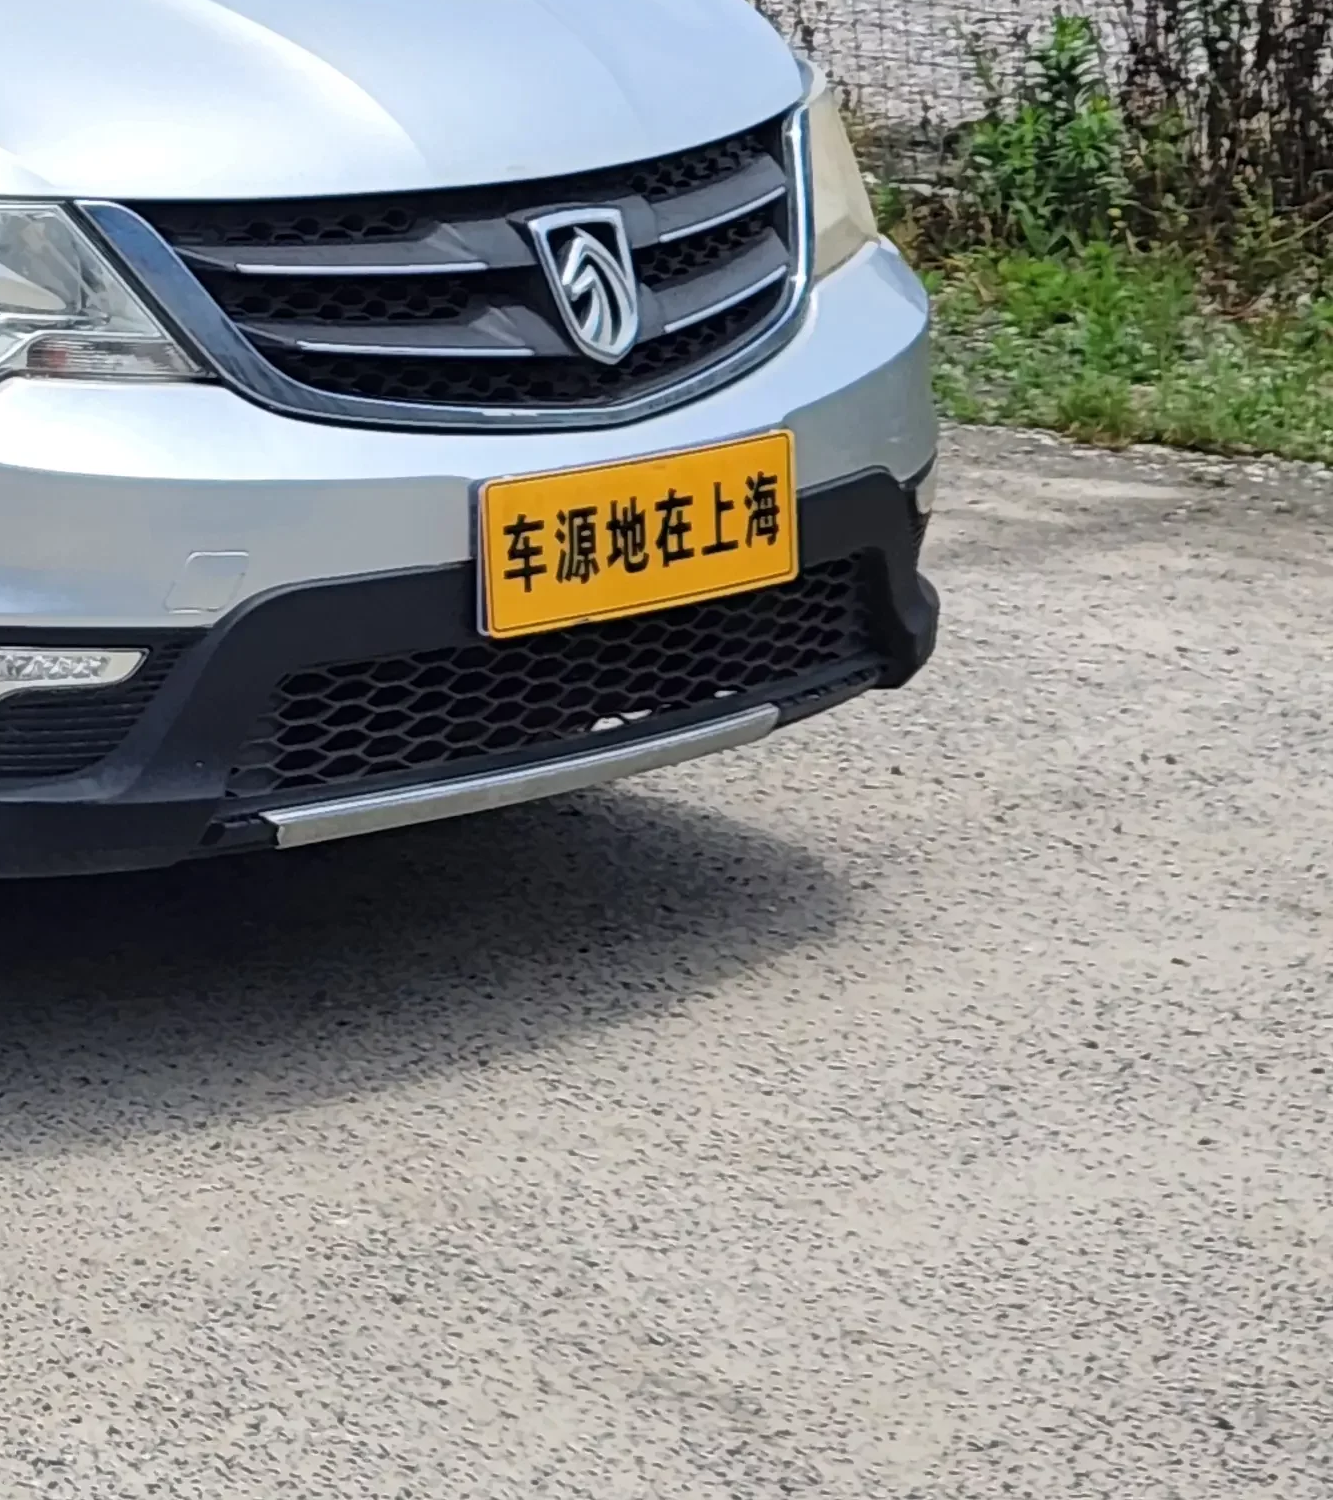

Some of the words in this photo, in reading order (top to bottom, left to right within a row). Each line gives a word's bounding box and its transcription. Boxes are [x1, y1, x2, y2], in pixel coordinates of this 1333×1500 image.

[503, 471, 781, 593] 车源地在上海
